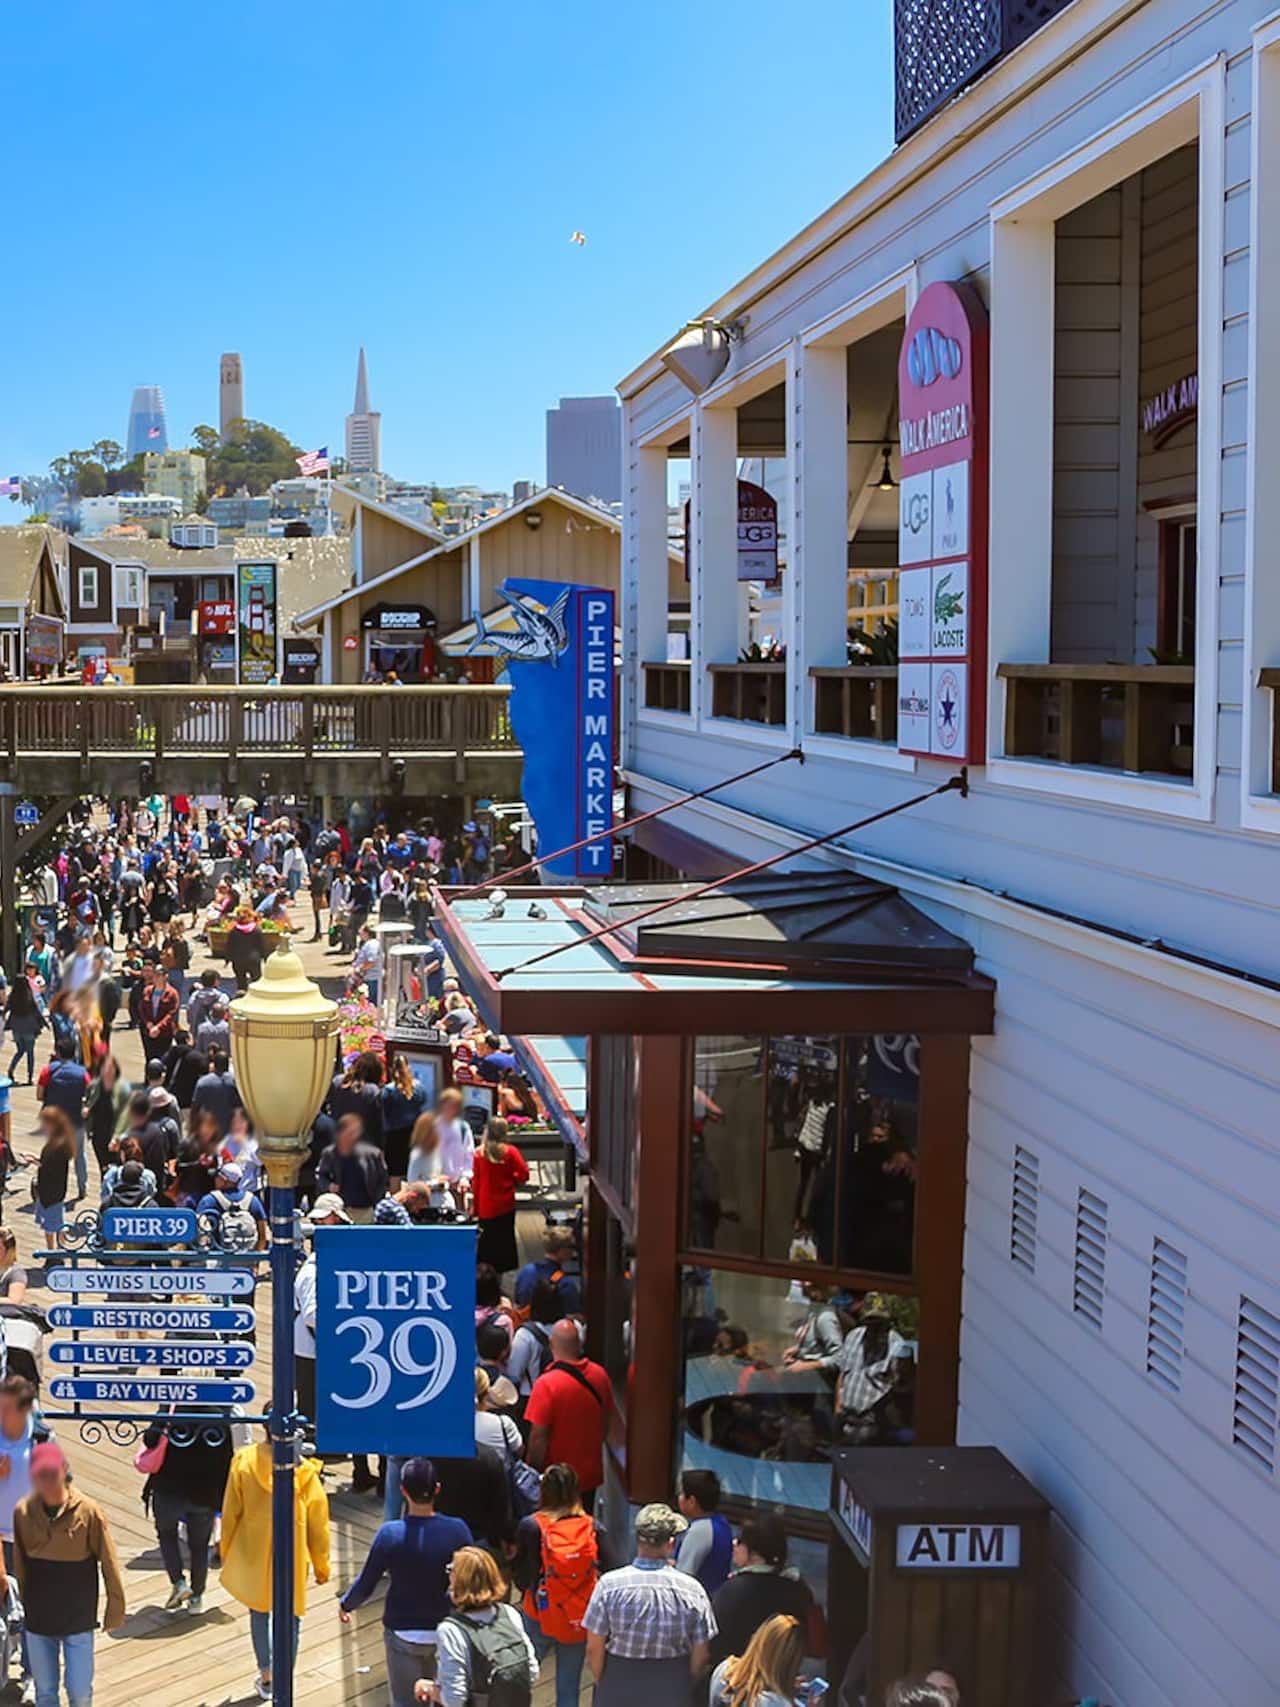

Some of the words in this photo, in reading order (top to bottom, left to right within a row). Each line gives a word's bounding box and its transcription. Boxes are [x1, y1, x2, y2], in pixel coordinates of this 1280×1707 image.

[1143, 384, 1177, 433] WALK
[899, 418, 926, 457] WALK
[926, 403, 968, 449] AMERICA
[902, 493, 929, 535] UGG
[587, 601, 607, 699] PIER
[933, 629, 964, 649] LACOSTE
[585, 715, 608, 866] MARKET
[113, 1217, 163, 1236] PIER
[167, 1217, 188, 1236] 39
[85, 1273, 144, 1290] SWISS
[149, 1275, 206, 1291] LOUIS
[334, 1270, 452, 1311] PIER
[92, 1311, 212, 1328] RESTROOMS
[83, 1346, 141, 1364] LEVEL
[145, 1348, 157, 1363] 2
[163, 1348, 227, 1365] SHOPS
[330, 1315, 457, 1410] 39
[95, 1383, 133, 1399] BAY
[135, 1384, 198, 1400] VIEWS
[907, 1527, 1005, 1562] ATM
